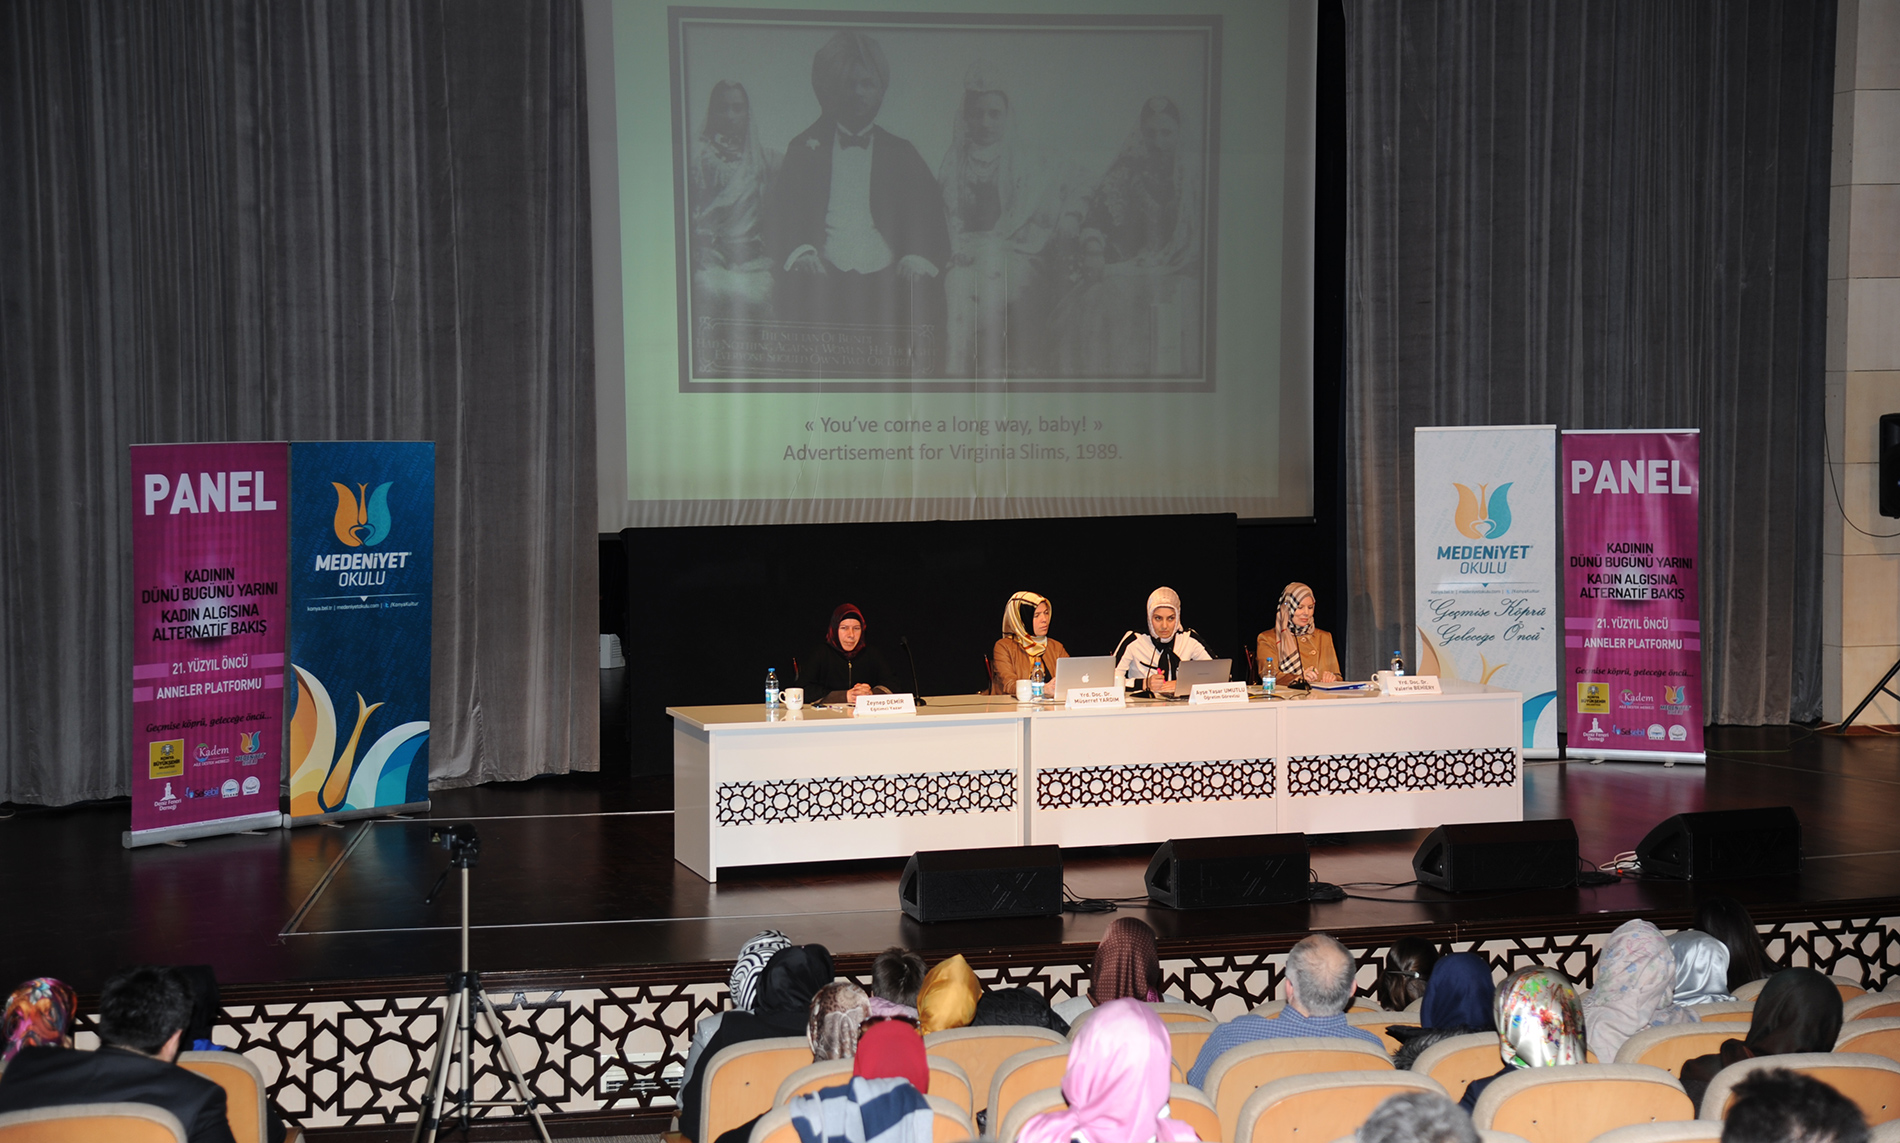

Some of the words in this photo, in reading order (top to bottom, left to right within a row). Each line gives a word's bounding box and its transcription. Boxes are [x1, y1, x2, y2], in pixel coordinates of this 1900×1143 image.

[884, 420, 931, 432] come
[938, 421, 946, 432] a
[952, 416, 990, 436] long
[996, 420, 1032, 435] way,
[1039, 416, 1086, 436] baby!
[783, 444, 914, 461] Advertisement
[919, 443, 943, 460] for
[950, 444, 1015, 463] Virginia
[1020, 444, 1069, 462] Slims,
[1076, 445, 1122, 460] 1989.
[1571, 460, 1691, 494] PANEL
[145, 471, 276, 515] PANEL
[1607, 543, 1653, 554] KADININ
[1460, 561, 1507, 574] OKULU
[1570, 553, 1602, 568] DÜNÜ
[1605, 554, 1653, 568] BUGÜNÜ
[1656, 557, 1692, 569] YARINI
[185, 567, 235, 583] KADININ
[339, 571, 386, 587] OKULU
[1587, 573, 1622, 585] KADIN
[1624, 574, 1677, 585] ALGISINA
[142, 585, 179, 604] DÜNÜ
[182, 581, 234, 601] BUGÜNÜ
[237, 582, 278, 597] YARINI
[1580, 585, 1648, 599] ALTERNATİF
[1651, 588, 1685, 603] BAKIŞ
[161, 607, 200, 623] KADIN
[202, 603, 259, 620] ALGISINA
[152, 620, 228, 642] ALTERNATİF
[231, 619, 267, 636] BAKIŞ
[1597, 618, 1610, 629] 21.
[1611, 616, 1642, 629] YÜZYIL
[1643, 617, 1669, 630] ÖNCÜ
[1584, 638, 1626, 648] ANNELER
[1628, 639, 1683, 650] PLATFORMU
[172, 662, 186, 675] 21.
[187, 658, 220, 673] YÜZYIL
[222, 653, 248, 670] ÖNCÜ
[156, 683, 203, 700] ANNELER
[204, 678, 262, 695] PLATFORMU
[1624, 692, 1654, 703] Kadem
[199, 744, 230, 758] Kadem
